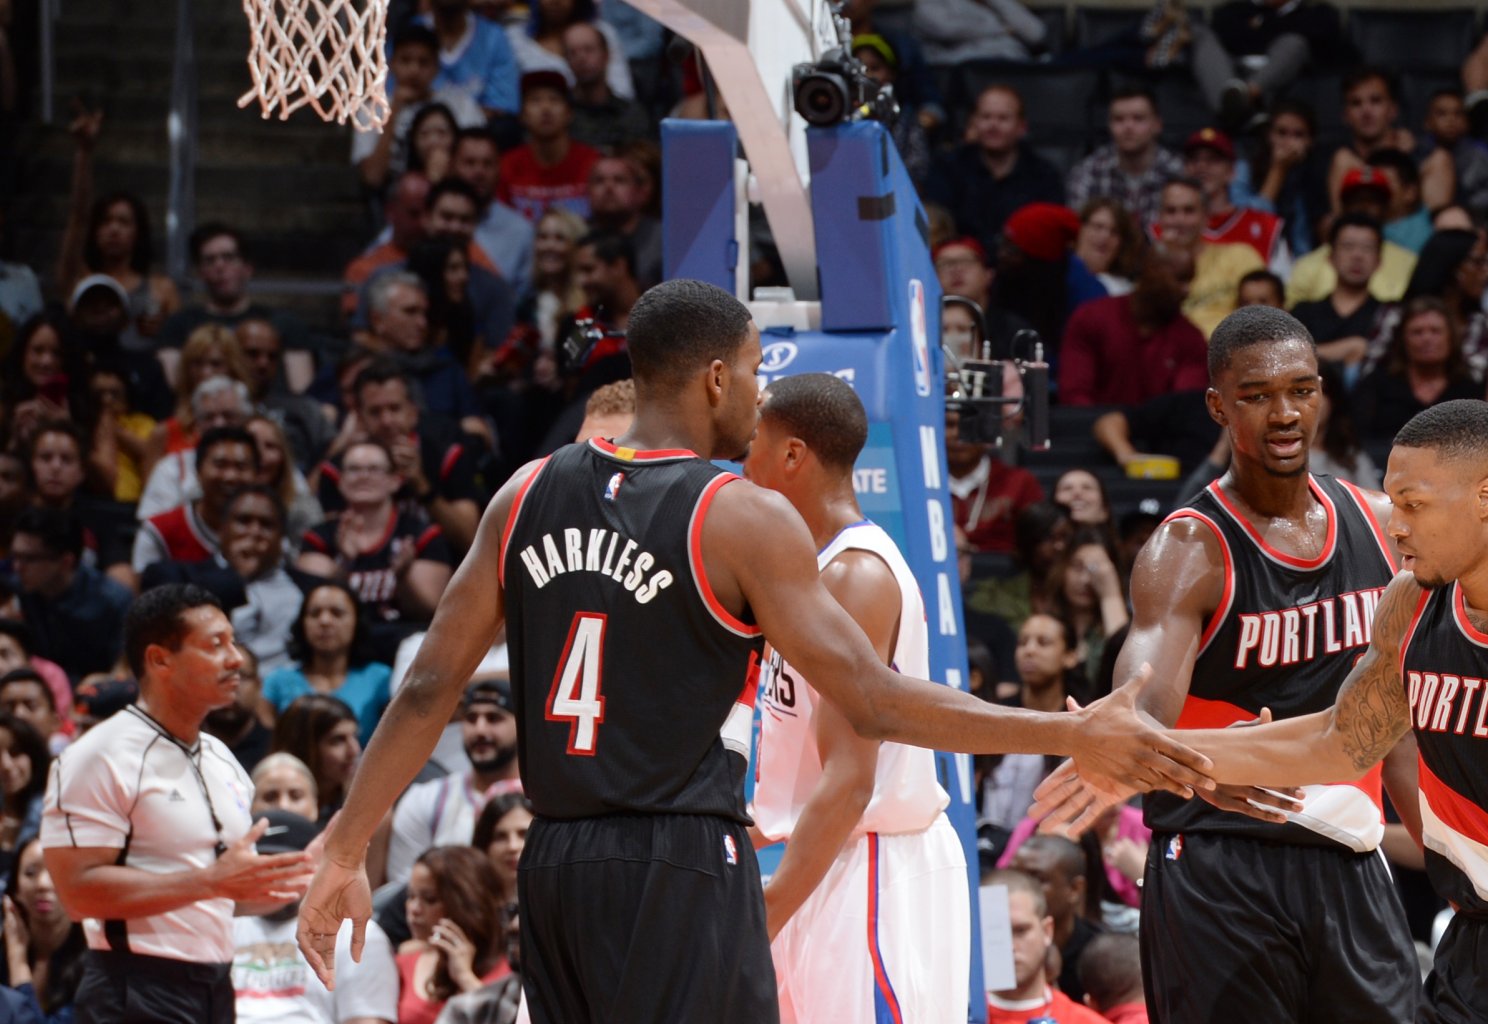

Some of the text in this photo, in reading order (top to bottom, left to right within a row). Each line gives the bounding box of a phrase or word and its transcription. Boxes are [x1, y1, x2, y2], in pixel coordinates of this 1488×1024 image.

[519, 527, 674, 605] HARKLESS
[919, 425, 957, 636] NBA
[544, 611, 608, 757] 4
[1233, 586, 1389, 670] PORTLAN
